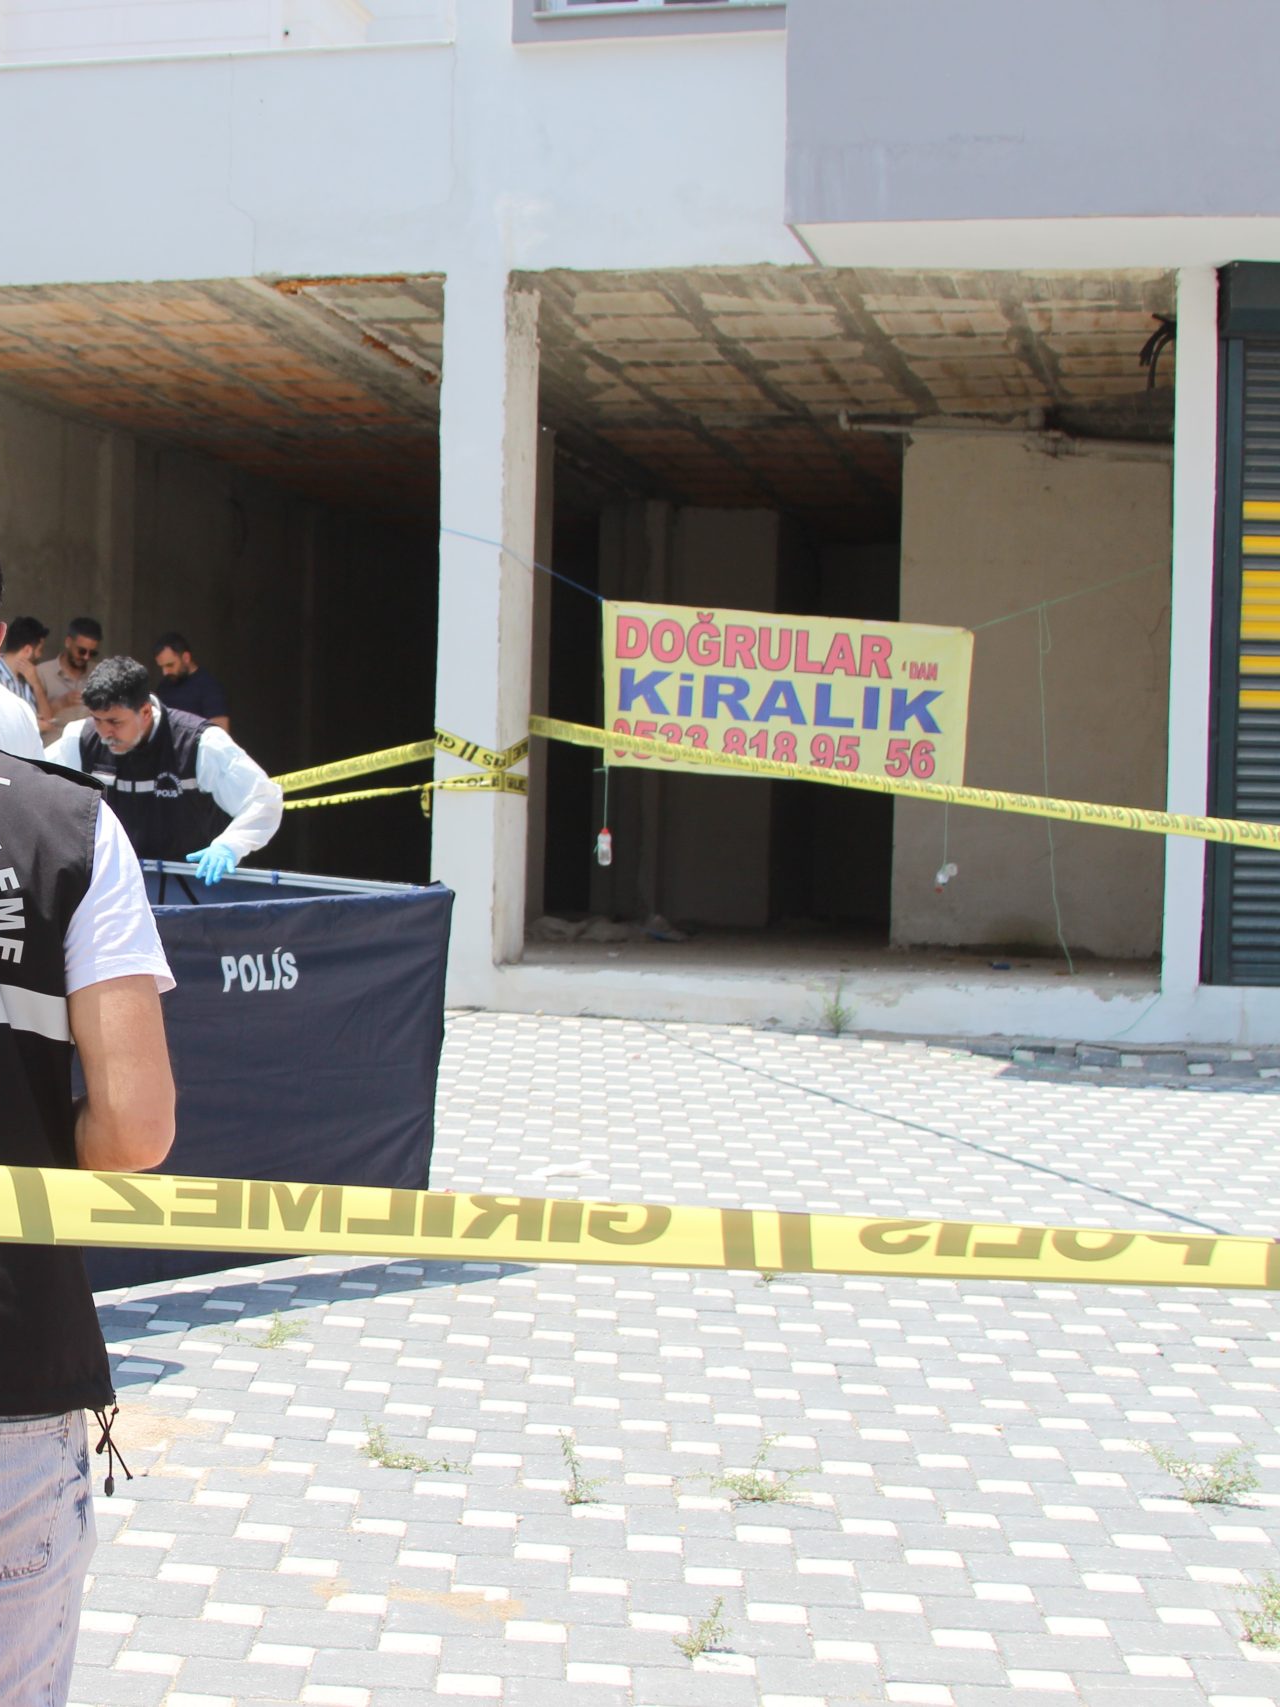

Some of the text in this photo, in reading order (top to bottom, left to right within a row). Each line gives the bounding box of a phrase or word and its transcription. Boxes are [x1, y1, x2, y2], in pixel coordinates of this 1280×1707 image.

[615, 612, 892, 679] DOĞRULAR
[809, 733, 861, 772] 95
[884, 738, 936, 779] 56
